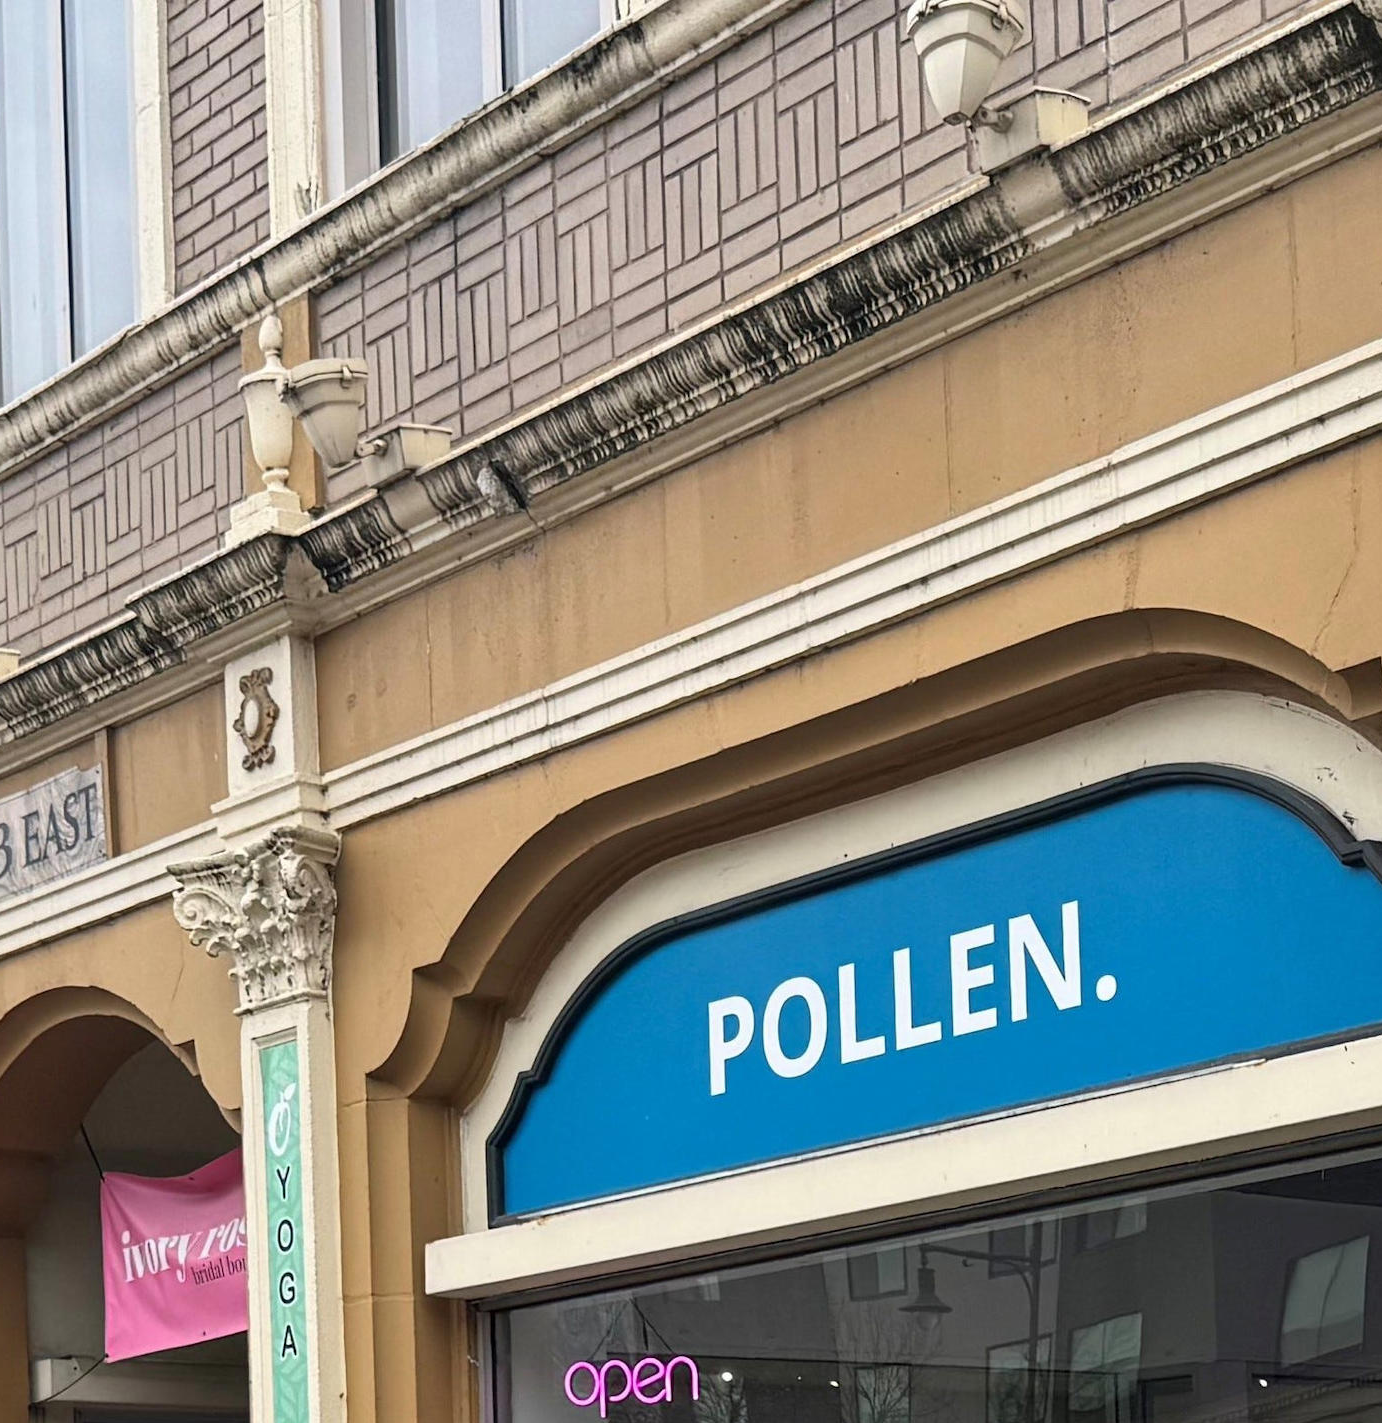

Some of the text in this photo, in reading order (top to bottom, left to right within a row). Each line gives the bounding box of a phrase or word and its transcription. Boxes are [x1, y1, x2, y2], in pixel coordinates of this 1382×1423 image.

[21, 782, 97, 868] EAST
[708, 900, 1117, 1096] POLLEN.
[121, 1230, 200, 1283] ivory
[191, 1259, 225, 1286] bridal
[276, 1165, 297, 1358] YOGA
[564, 1355, 699, 1418] open
